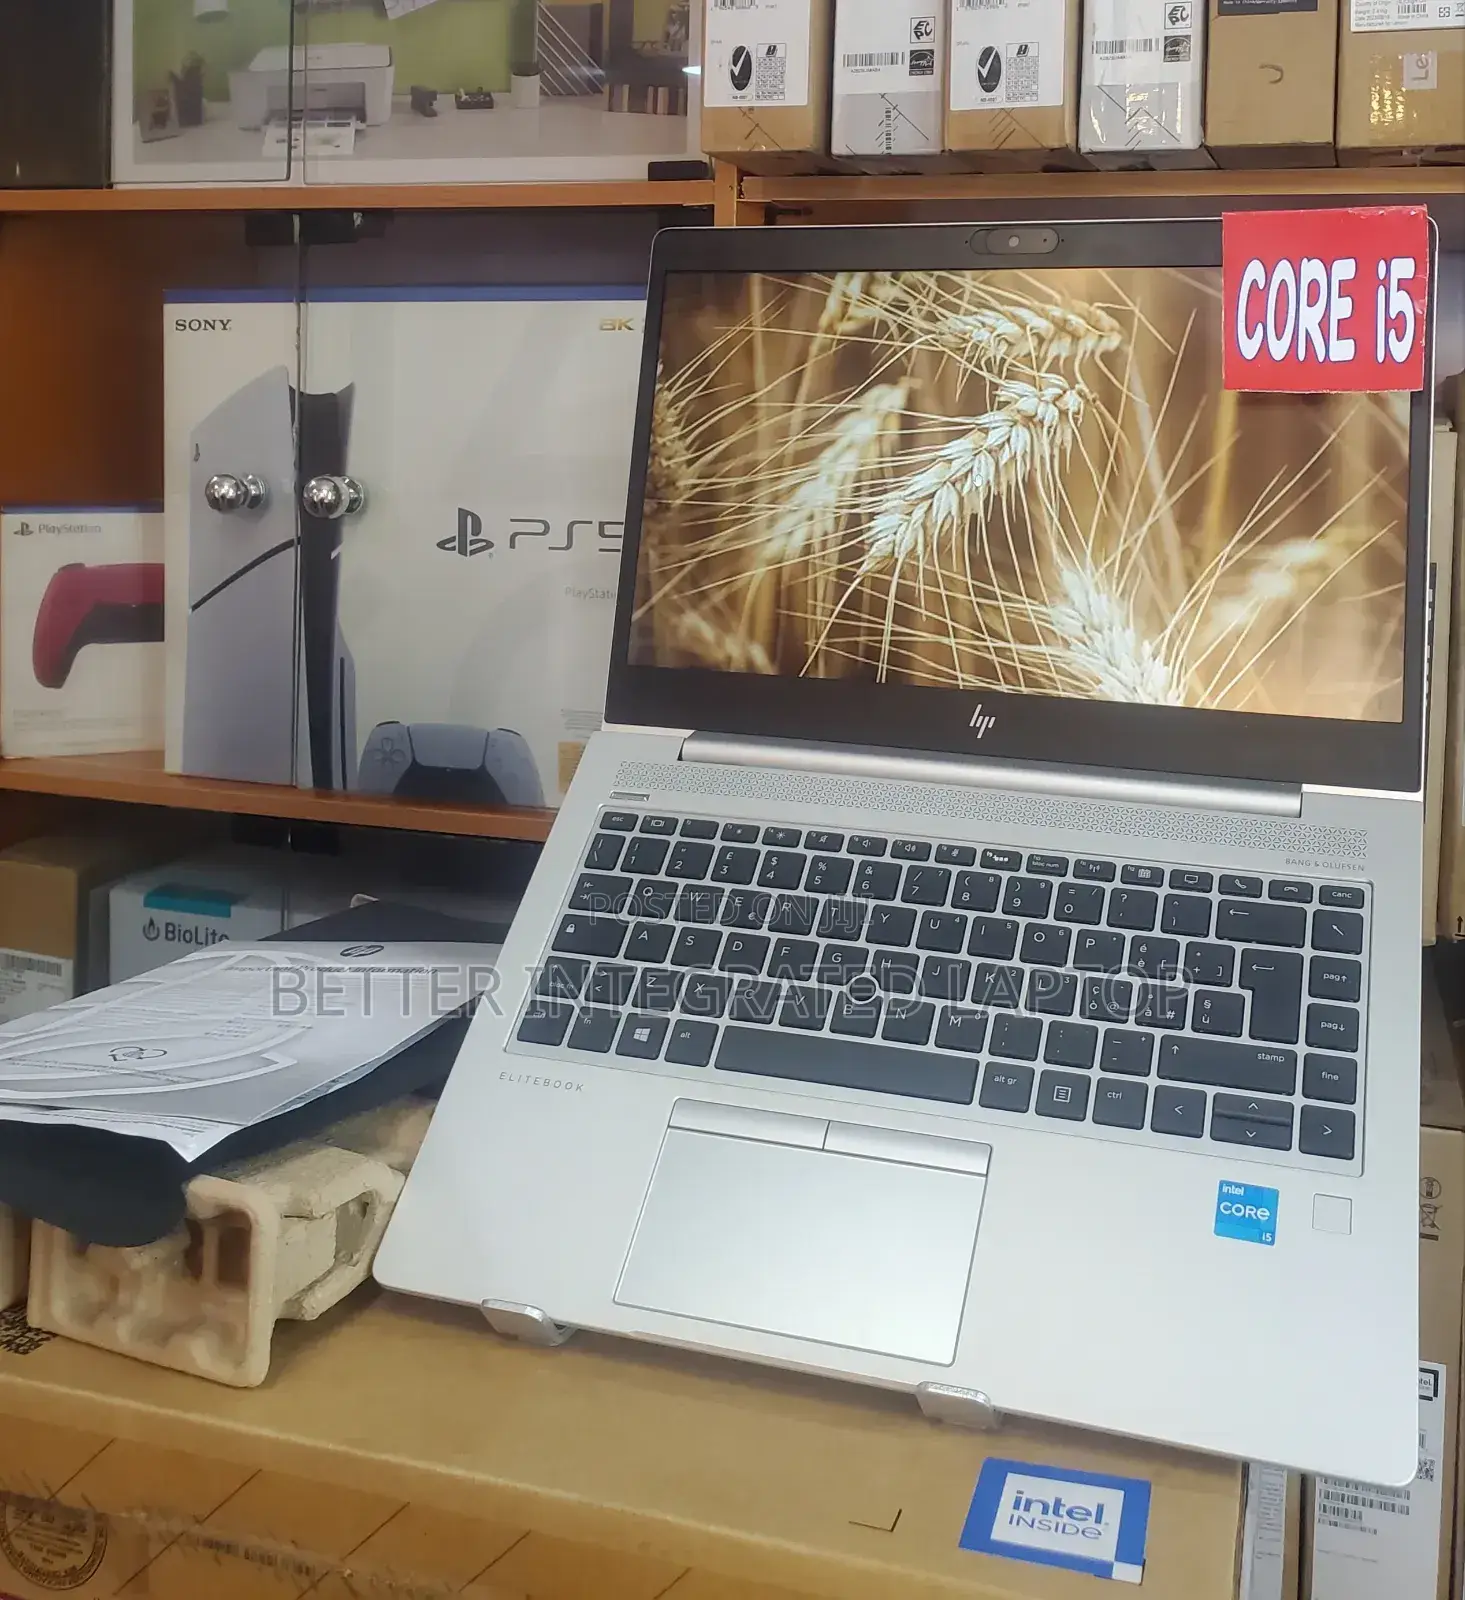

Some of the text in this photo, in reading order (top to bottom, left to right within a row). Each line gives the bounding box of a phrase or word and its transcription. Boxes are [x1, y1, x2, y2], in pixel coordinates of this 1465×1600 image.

[1237, 257, 1416, 363] CORE i5
[175, 318, 231, 331] SONY
[599, 318, 634, 331] 8K
[726, 852, 734, 860] £
[770, 856, 778, 866] $
[675, 861, 683, 870] 2
[818, 862, 827, 871] %
[1285, 858, 1311, 866] BANG
[1322, 862, 1365, 871] OLUFSEN
[720, 866, 728, 874] 3
[766, 871, 775, 879] 4
[865, 866, 873, 875] &
[813, 876, 822, 885] 5
[862, 881, 870, 890] 6
[643, 886, 654, 897] Q
[911, 886, 919, 895] 7
[1331, 891, 1353, 899] canc
[690, 892, 704, 901] W
[734, 896, 744, 906] E
[961, 892, 970, 901] 8
[781, 902, 791, 912] R
[1013, 898, 1021, 907] 9
[830, 907, 839, 917] T
[880, 913, 890, 923] Y
[930, 919, 941, 930] U
[638, 930, 649, 940] A
[1033, 932, 1046, 943] O
[685, 936, 695, 945] S
[1086, 938, 1096, 948] P
[732, 941, 743, 951] D
[1139, 943, 1147, 953] é
[780, 947, 791, 956] F
[832, 953, 842, 963] G
[1137, 958, 1146, 968] è
[881, 959, 892, 968] H
[932, 965, 941, 976] J
[646, 977, 657, 987] Z
[985, 973, 995, 983] K
[693, 983, 705, 993] X
[1089, 1000, 1098, 1010] ò
[895, 1009, 907, 1019] N
[1145, 1008, 1152, 1017] à
[950, 1016, 962, 1027] M
[1202, 1015, 1210, 1024] ù
[680, 1031, 691, 1039] alt
[1257, 1052, 1285, 1063] stamp
[994, 1075, 1017, 1086] alt gr
[1321, 1071, 1339, 1081] fine
[499, 1071, 584, 1092] ELITEBOOK
[1107, 1091, 1122, 1100] ctrl
[1222, 1183, 1244, 1196] intel
[1262, 1232, 1272, 1242] i5
